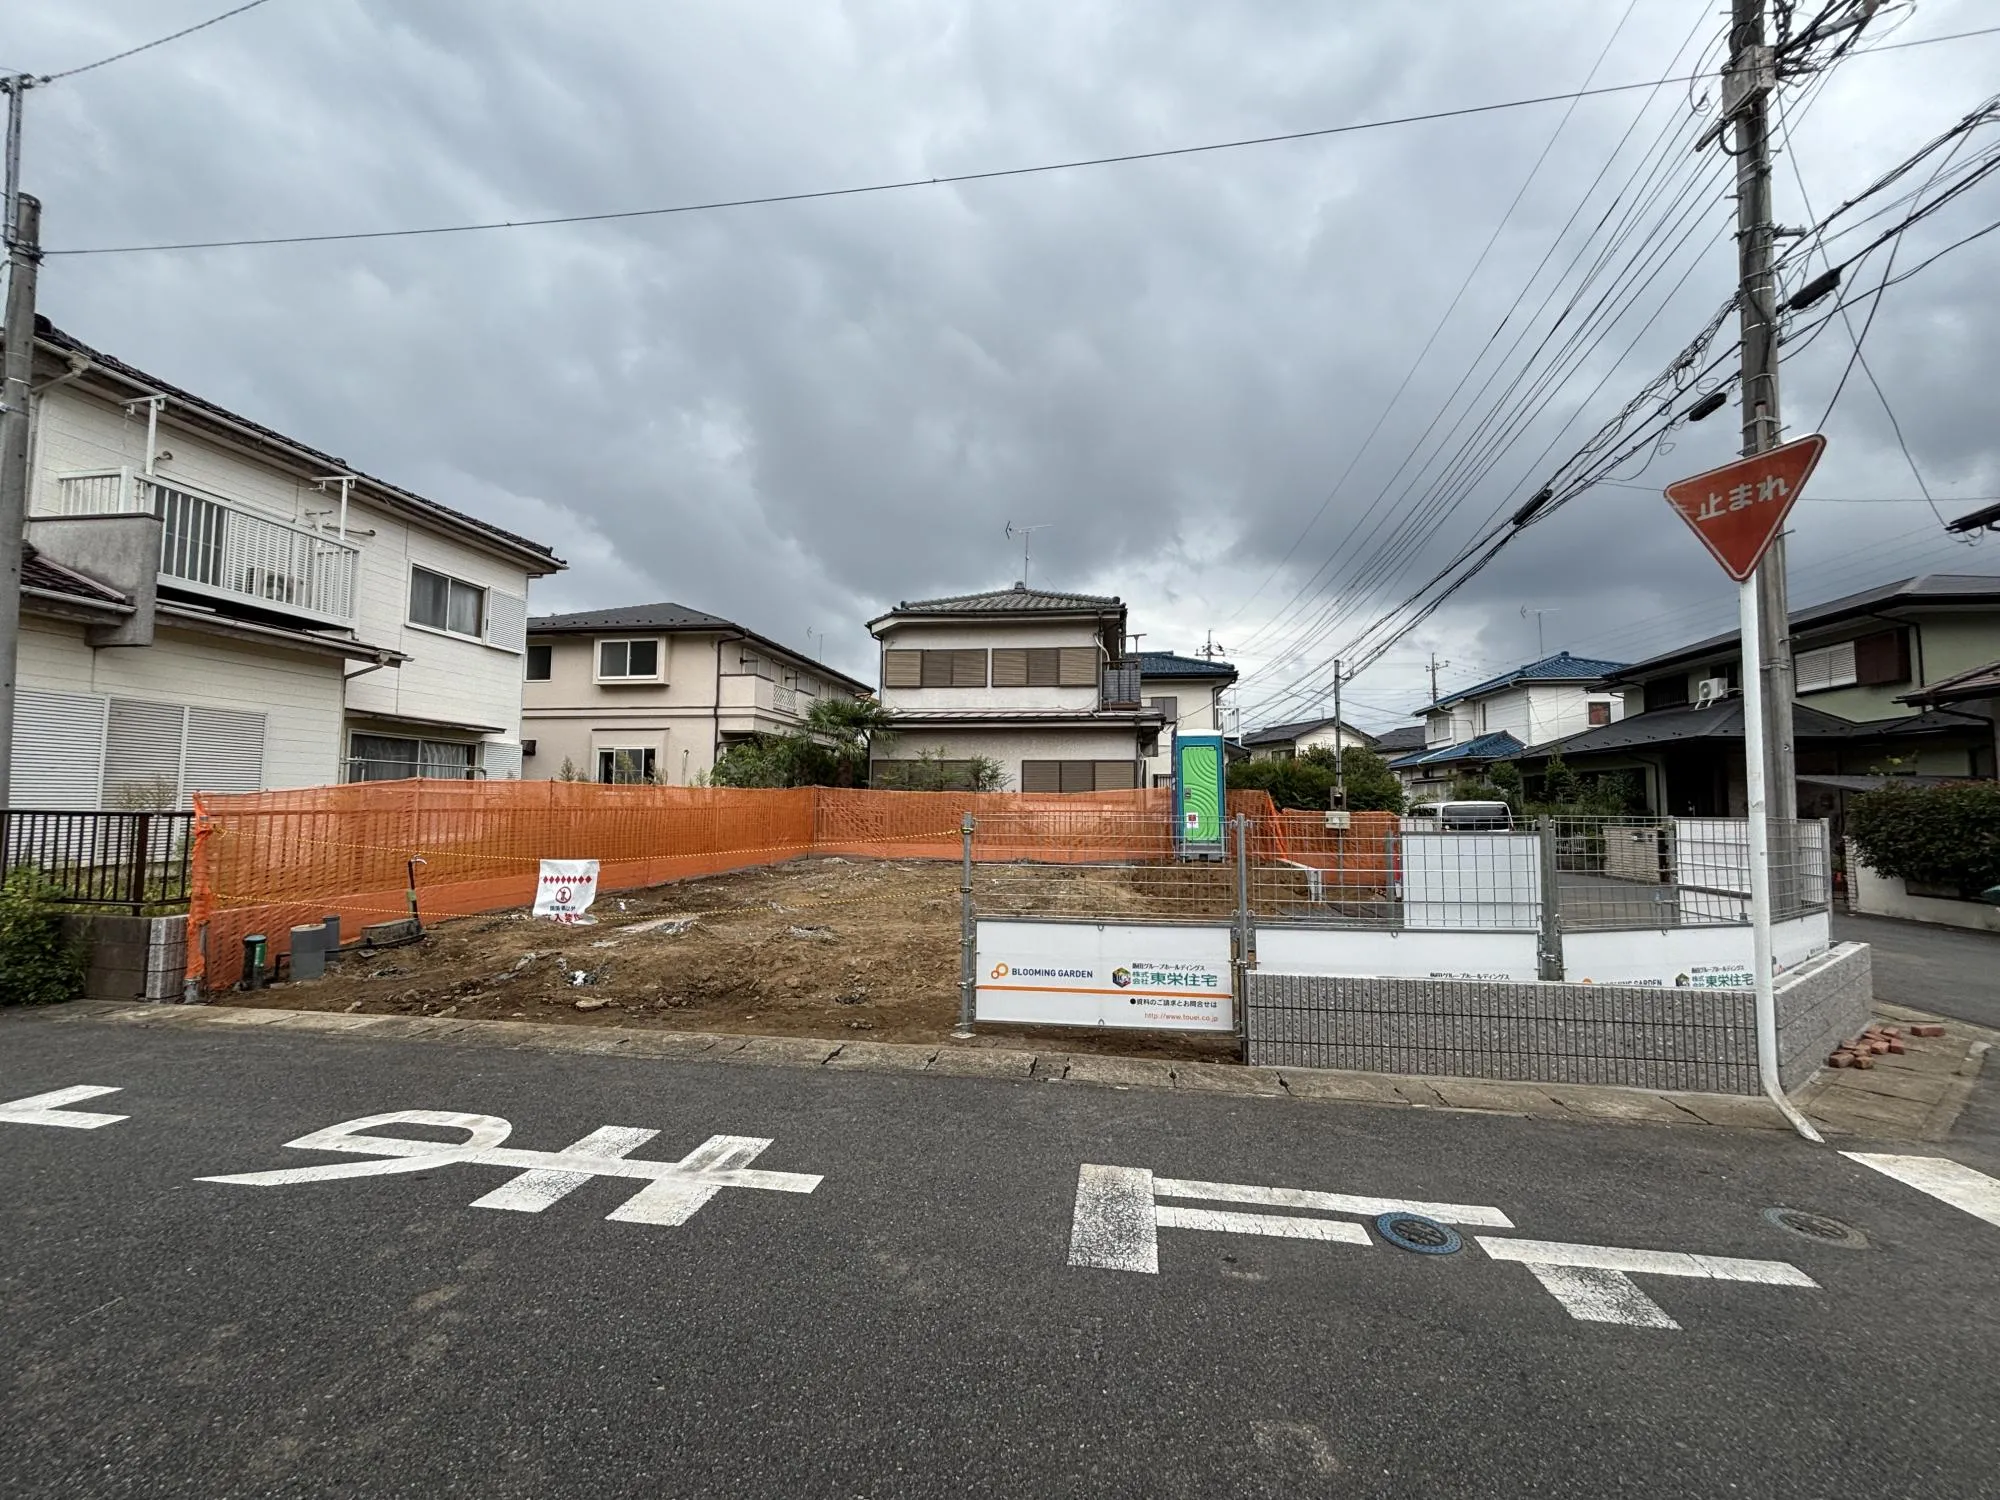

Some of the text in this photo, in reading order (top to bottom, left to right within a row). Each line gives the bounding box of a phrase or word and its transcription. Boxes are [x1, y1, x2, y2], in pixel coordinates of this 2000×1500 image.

[1696, 475, 1790, 522] 止まれ
[1011, 967, 1093, 978] BLOOMING GARDEN
[1150, 972, 1218, 987] 東栄住宅
[1705, 973, 1754, 988] 東栄住宅
[1144, 1012, 1218, 1023] http://www.touei.co.jp
